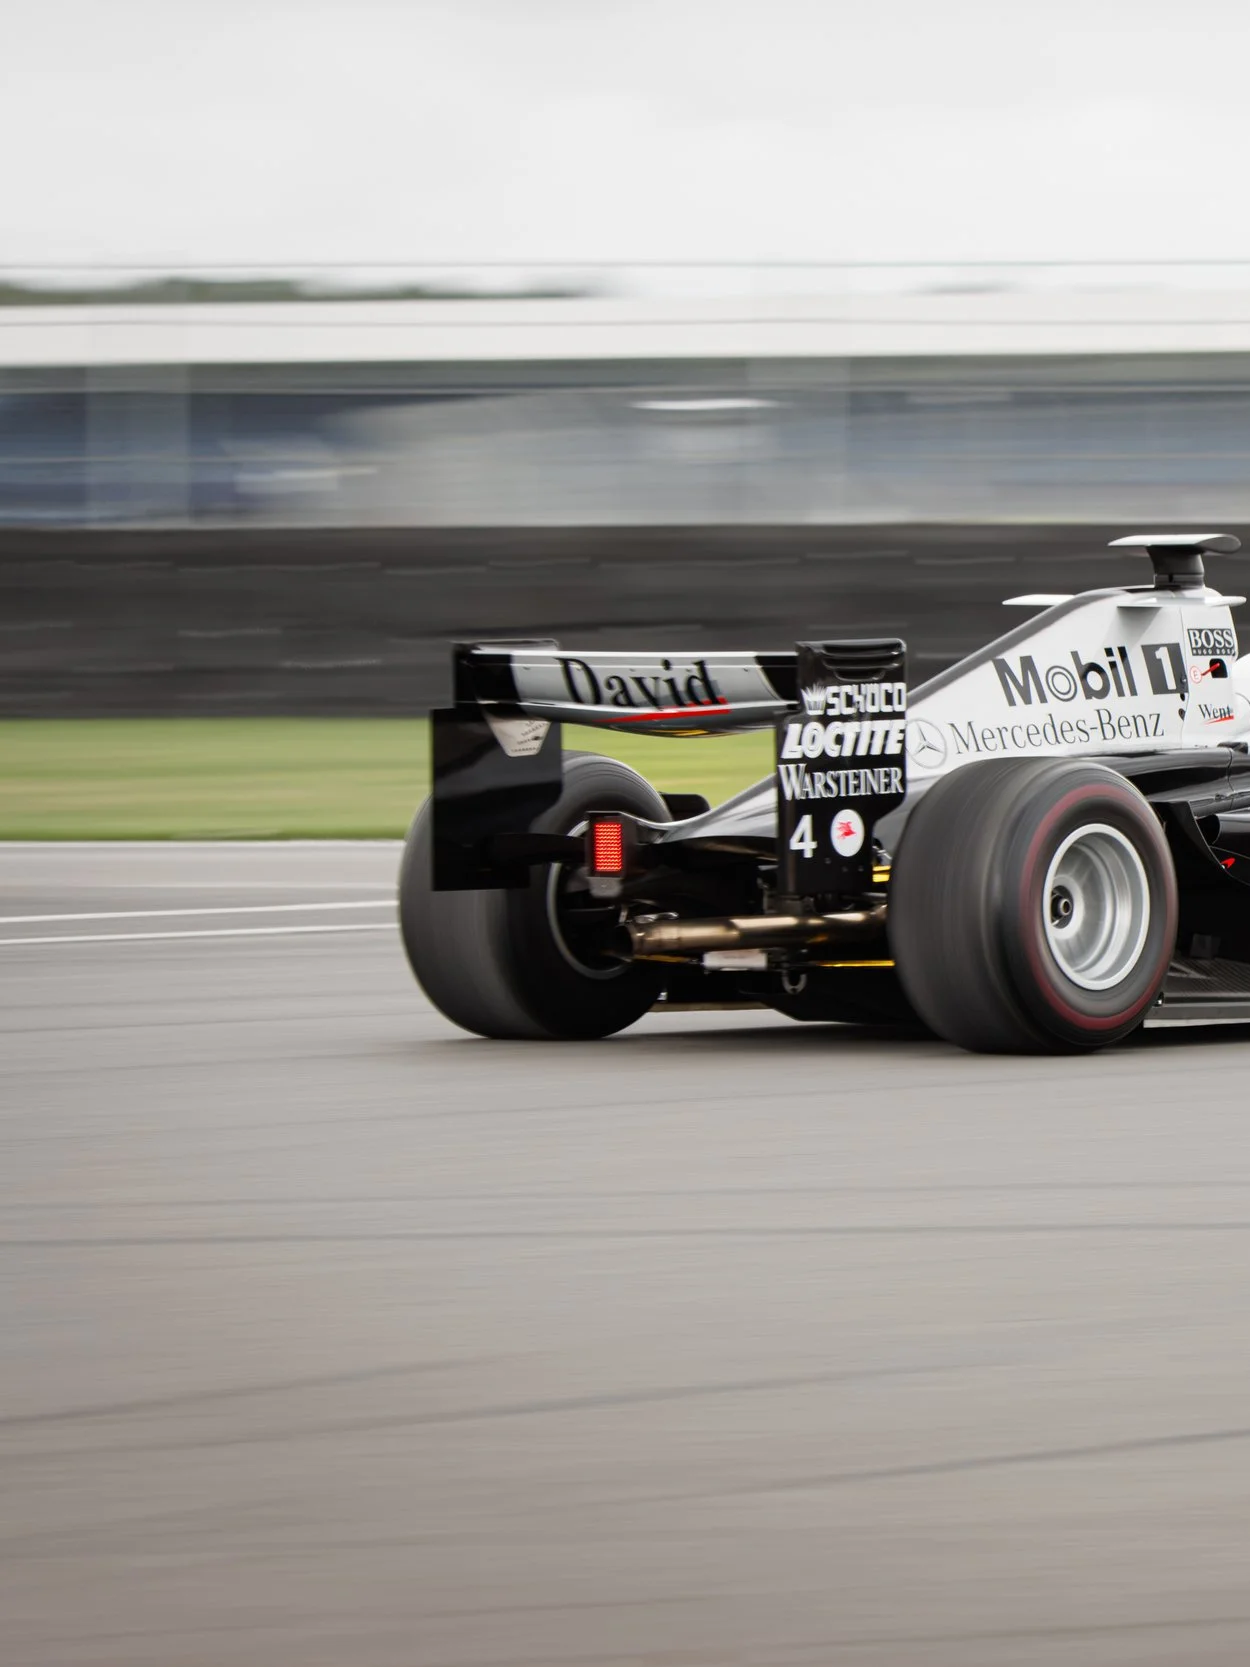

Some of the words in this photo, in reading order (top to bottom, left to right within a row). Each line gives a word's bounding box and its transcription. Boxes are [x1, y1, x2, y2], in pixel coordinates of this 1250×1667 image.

[1188, 629, 1234, 649] BOSS
[553, 656, 723, 711] David
[992, 646, 1138, 706] Mobil
[781, 719, 907, 760] LOCTITE
[947, 708, 1165, 755] Mercedes-Benz
[789, 814, 818, 859] 4
